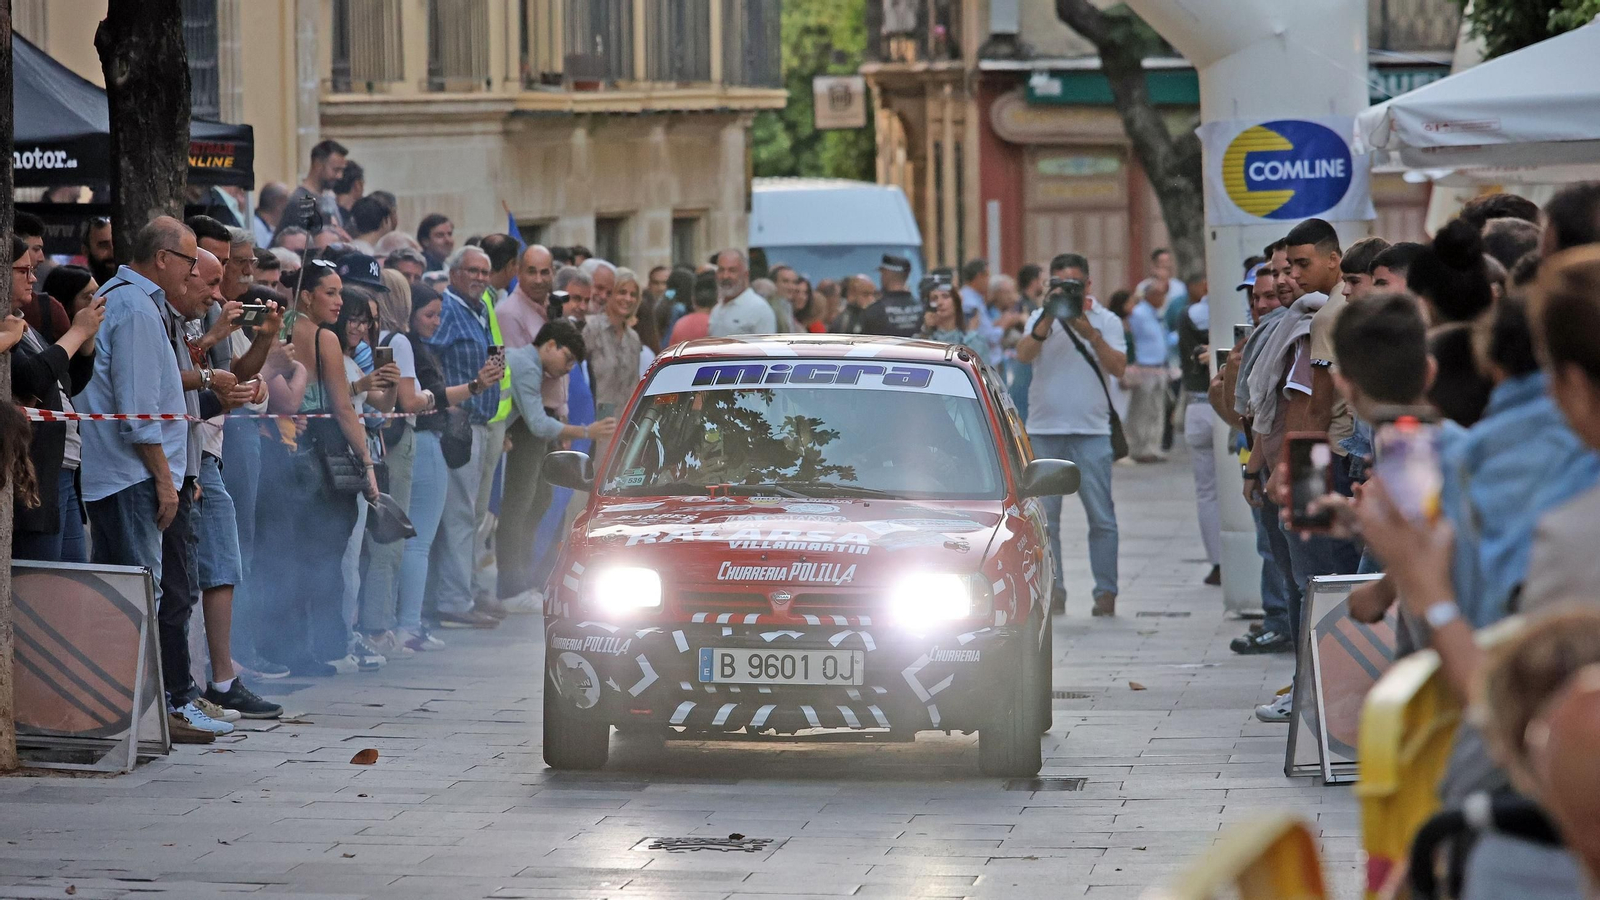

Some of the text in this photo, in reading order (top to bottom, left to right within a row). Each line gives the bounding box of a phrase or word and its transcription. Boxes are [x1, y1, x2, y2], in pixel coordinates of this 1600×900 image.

[188, 156, 235, 168] NLINE
[1249, 158, 1346, 182] COMLINE
[369, 261, 379, 277] NY
[625, 528, 870, 546] RALARSA
[717, 561, 857, 586] CHURRERIA POLILLA
[583, 636, 632, 656] POLILLA
[930, 645, 980, 662] CHURRERIA
[720, 652, 736, 679] B
[747, 653, 809, 680] 9601
